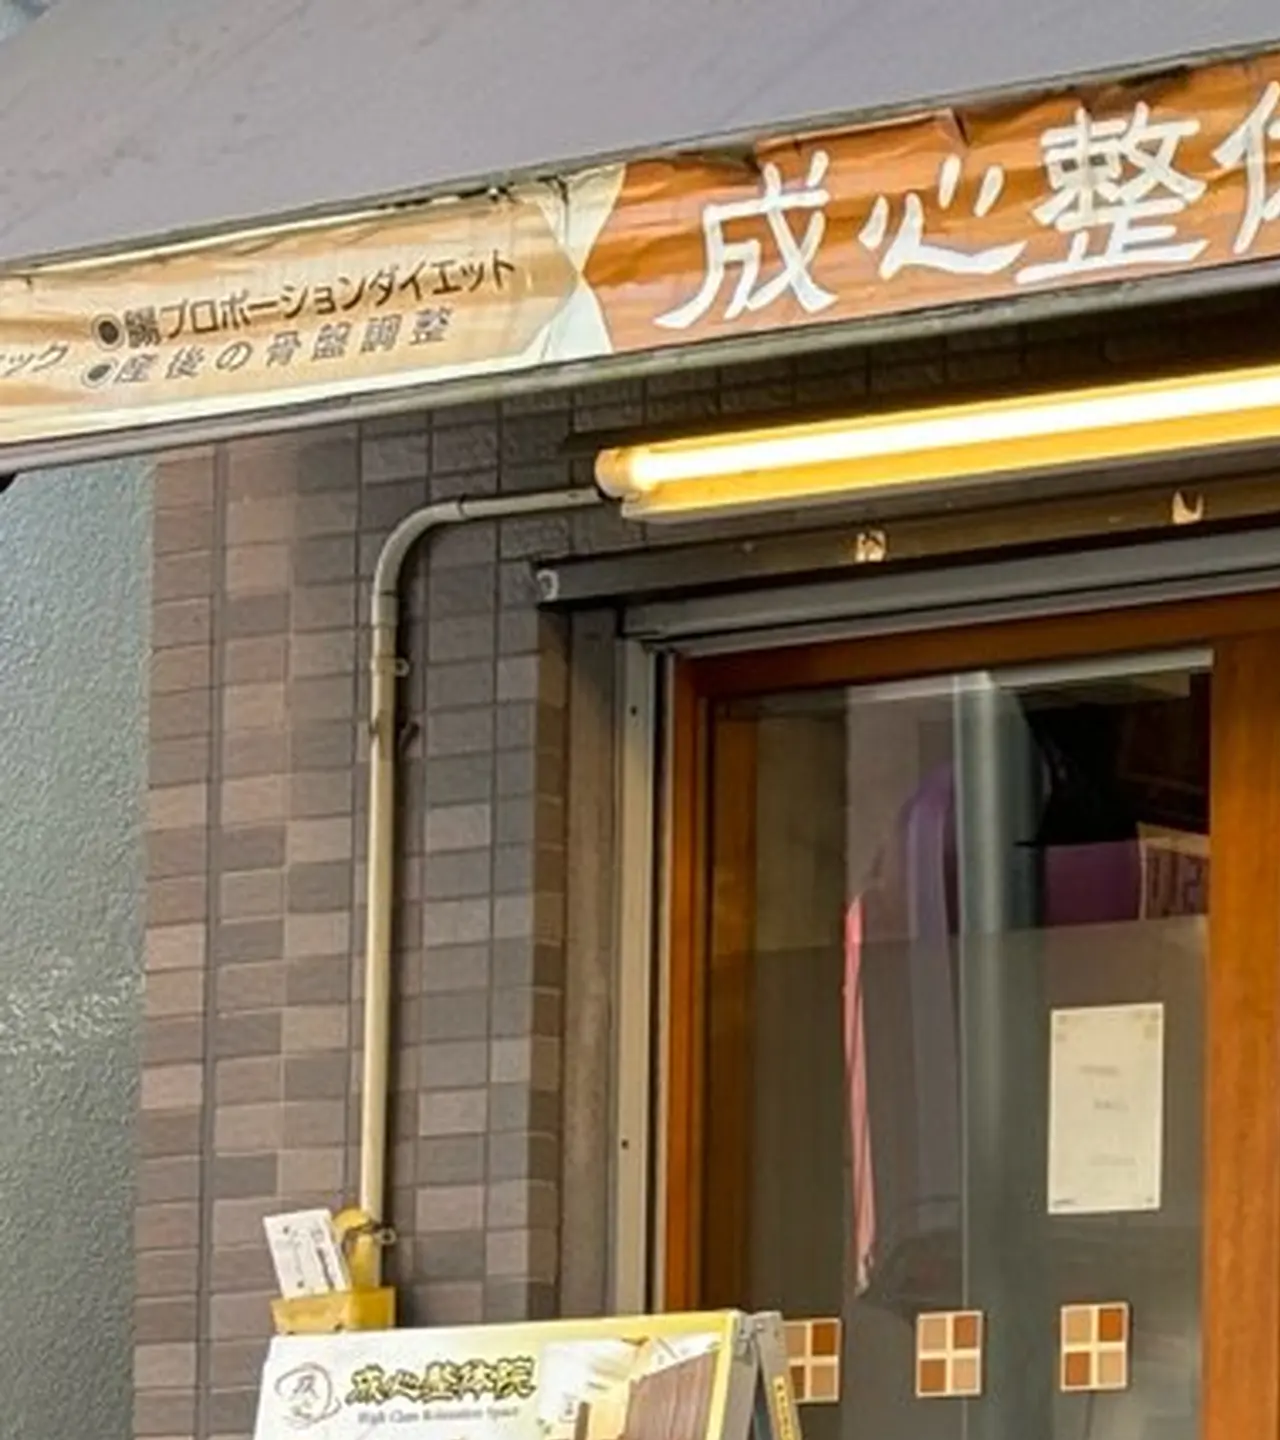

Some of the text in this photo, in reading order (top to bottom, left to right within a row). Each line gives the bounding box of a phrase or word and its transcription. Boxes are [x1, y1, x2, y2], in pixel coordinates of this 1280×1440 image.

[113, 307, 454, 386] 産後の骨盤調整
